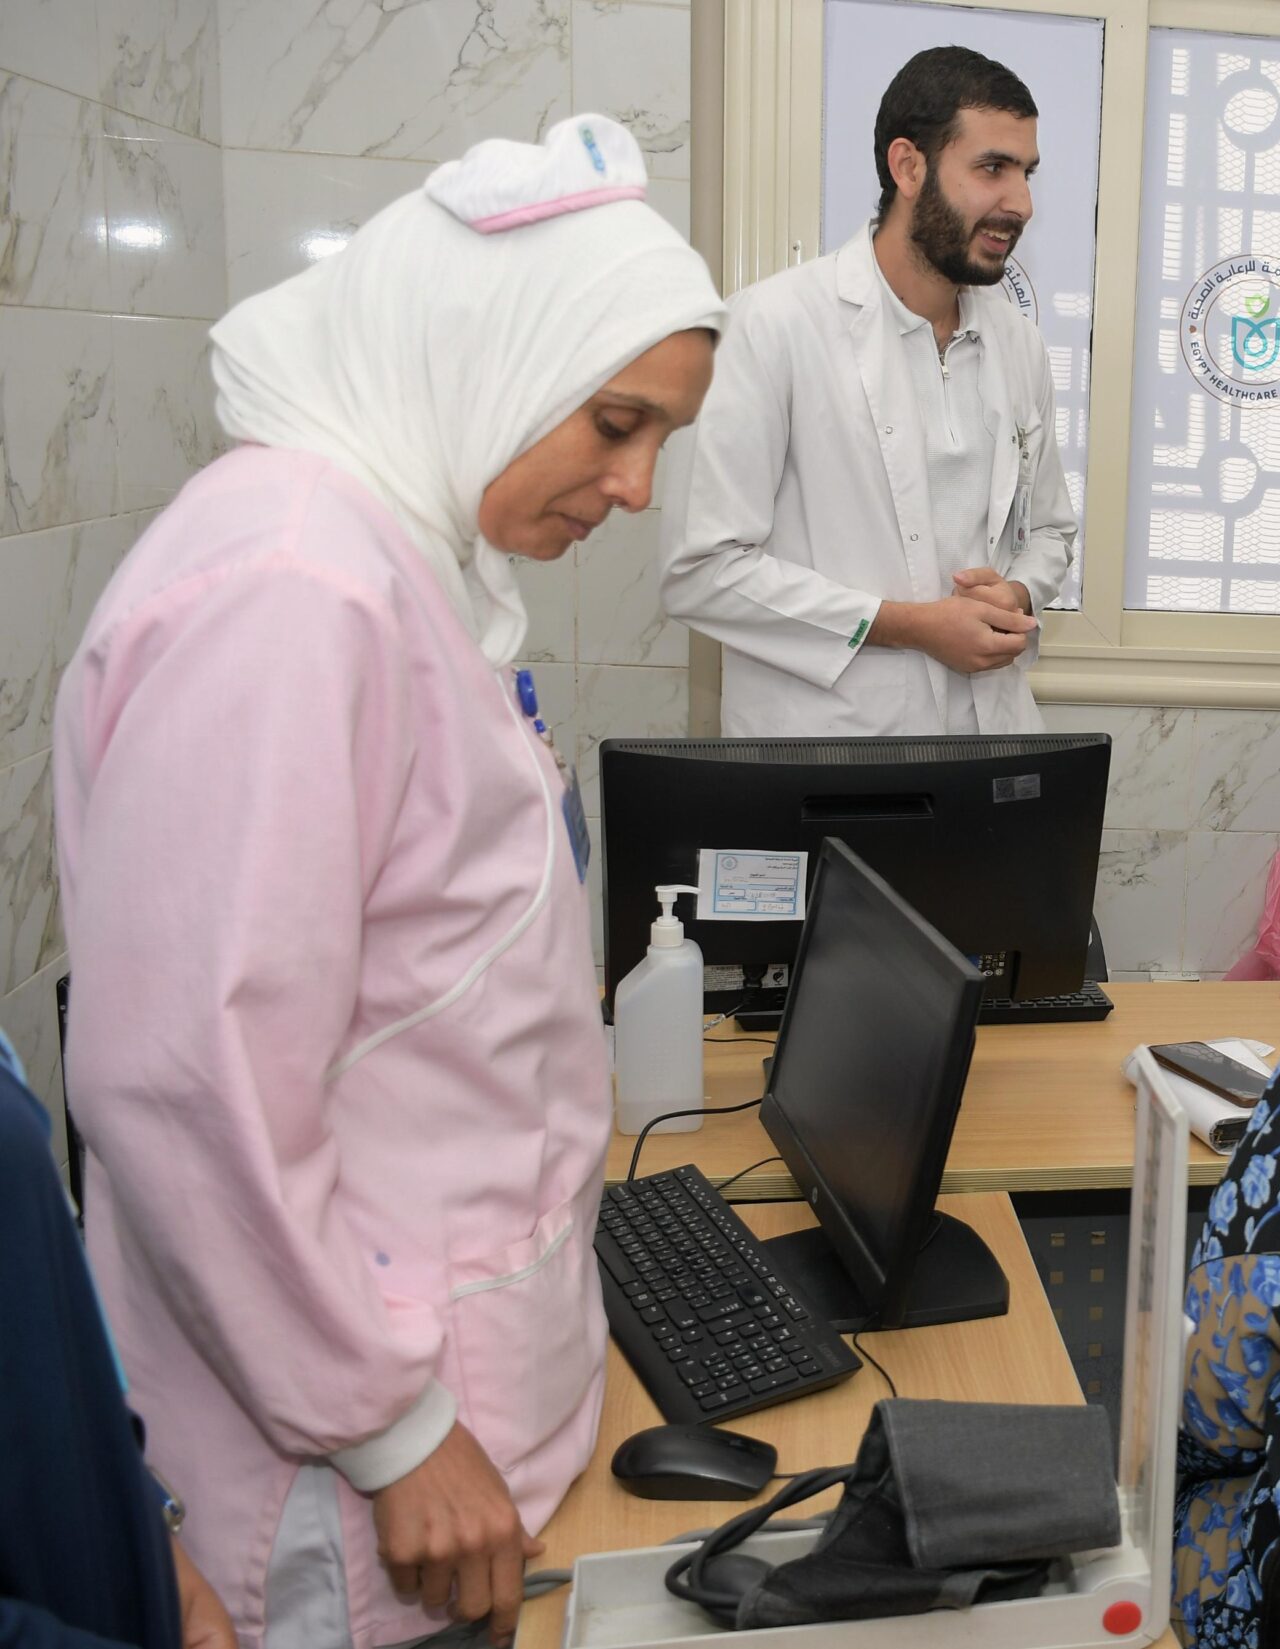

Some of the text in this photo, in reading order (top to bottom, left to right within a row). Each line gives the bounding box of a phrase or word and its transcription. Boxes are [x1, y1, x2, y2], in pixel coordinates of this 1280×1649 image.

[1215, 260, 1256, 283] للرعاية
[1188, 278, 1216, 320] الصحية
[1190, 341, 1211, 375] EGYPT
[1209, 374, 1278, 401] HEALTHCARE
